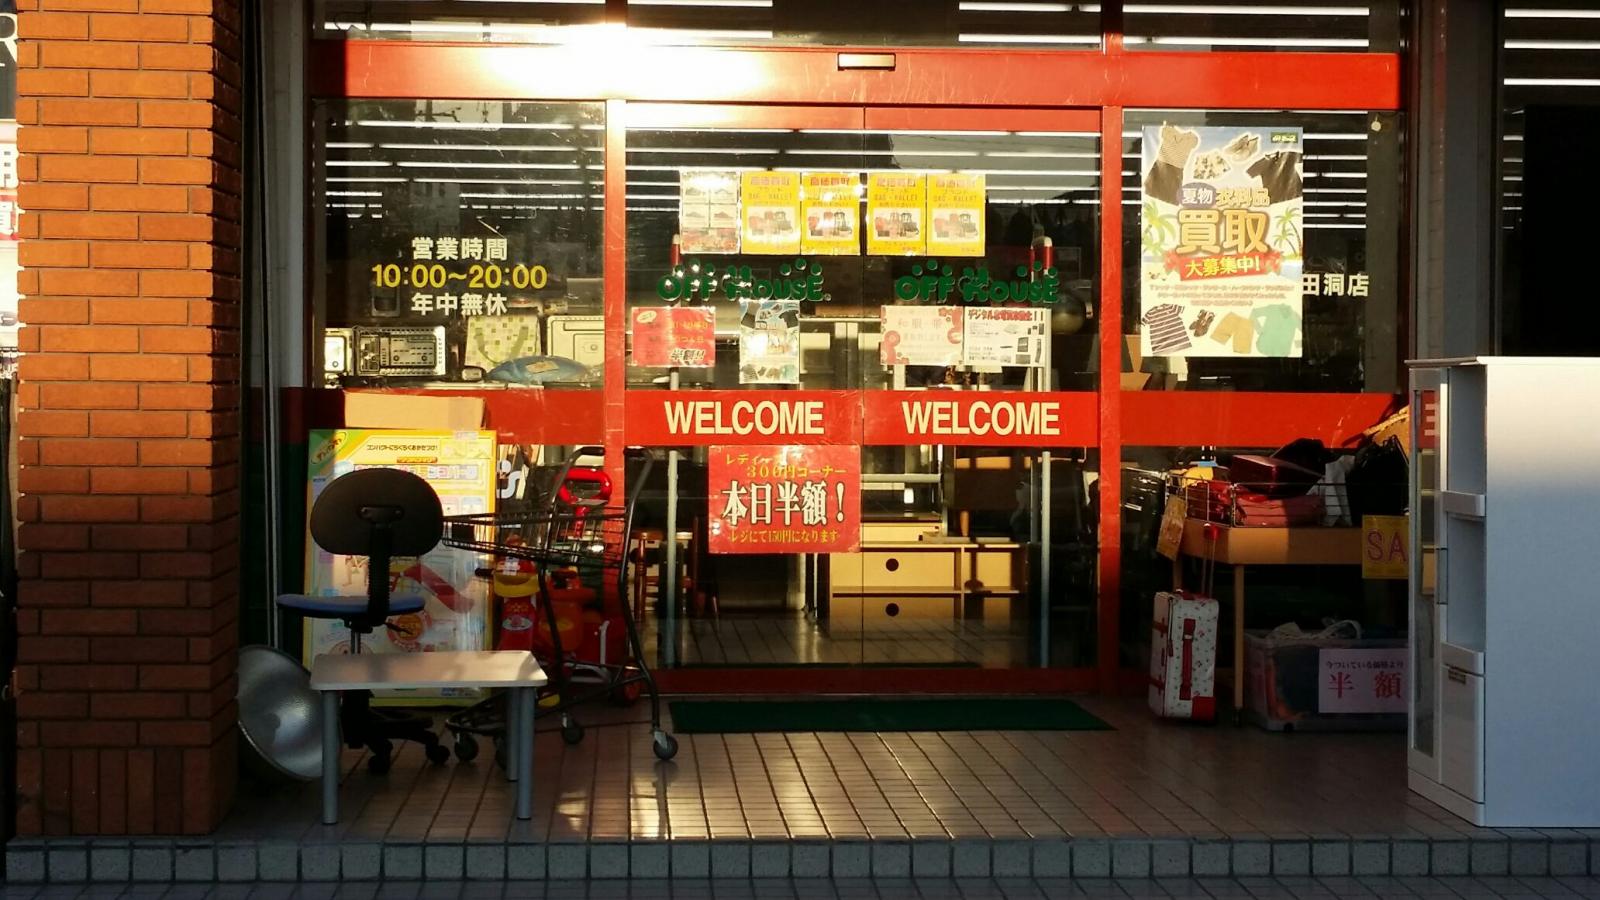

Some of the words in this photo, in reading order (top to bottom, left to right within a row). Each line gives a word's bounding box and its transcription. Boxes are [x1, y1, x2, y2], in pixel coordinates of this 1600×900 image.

[1181, 187, 1214, 205] 夏物
[411, 236, 508, 262] 営業時間
[1176, 208, 1270, 255] 買取
[1185, 256, 1261, 278] 大募集中!
[894, 267, 956, 304] OFF
[411, 292, 508, 316] 年中無休
[664, 400, 825, 436] WELCOME
[901, 401, 1061, 436] WELCOME
[721, 480, 846, 526] 本日半額!
